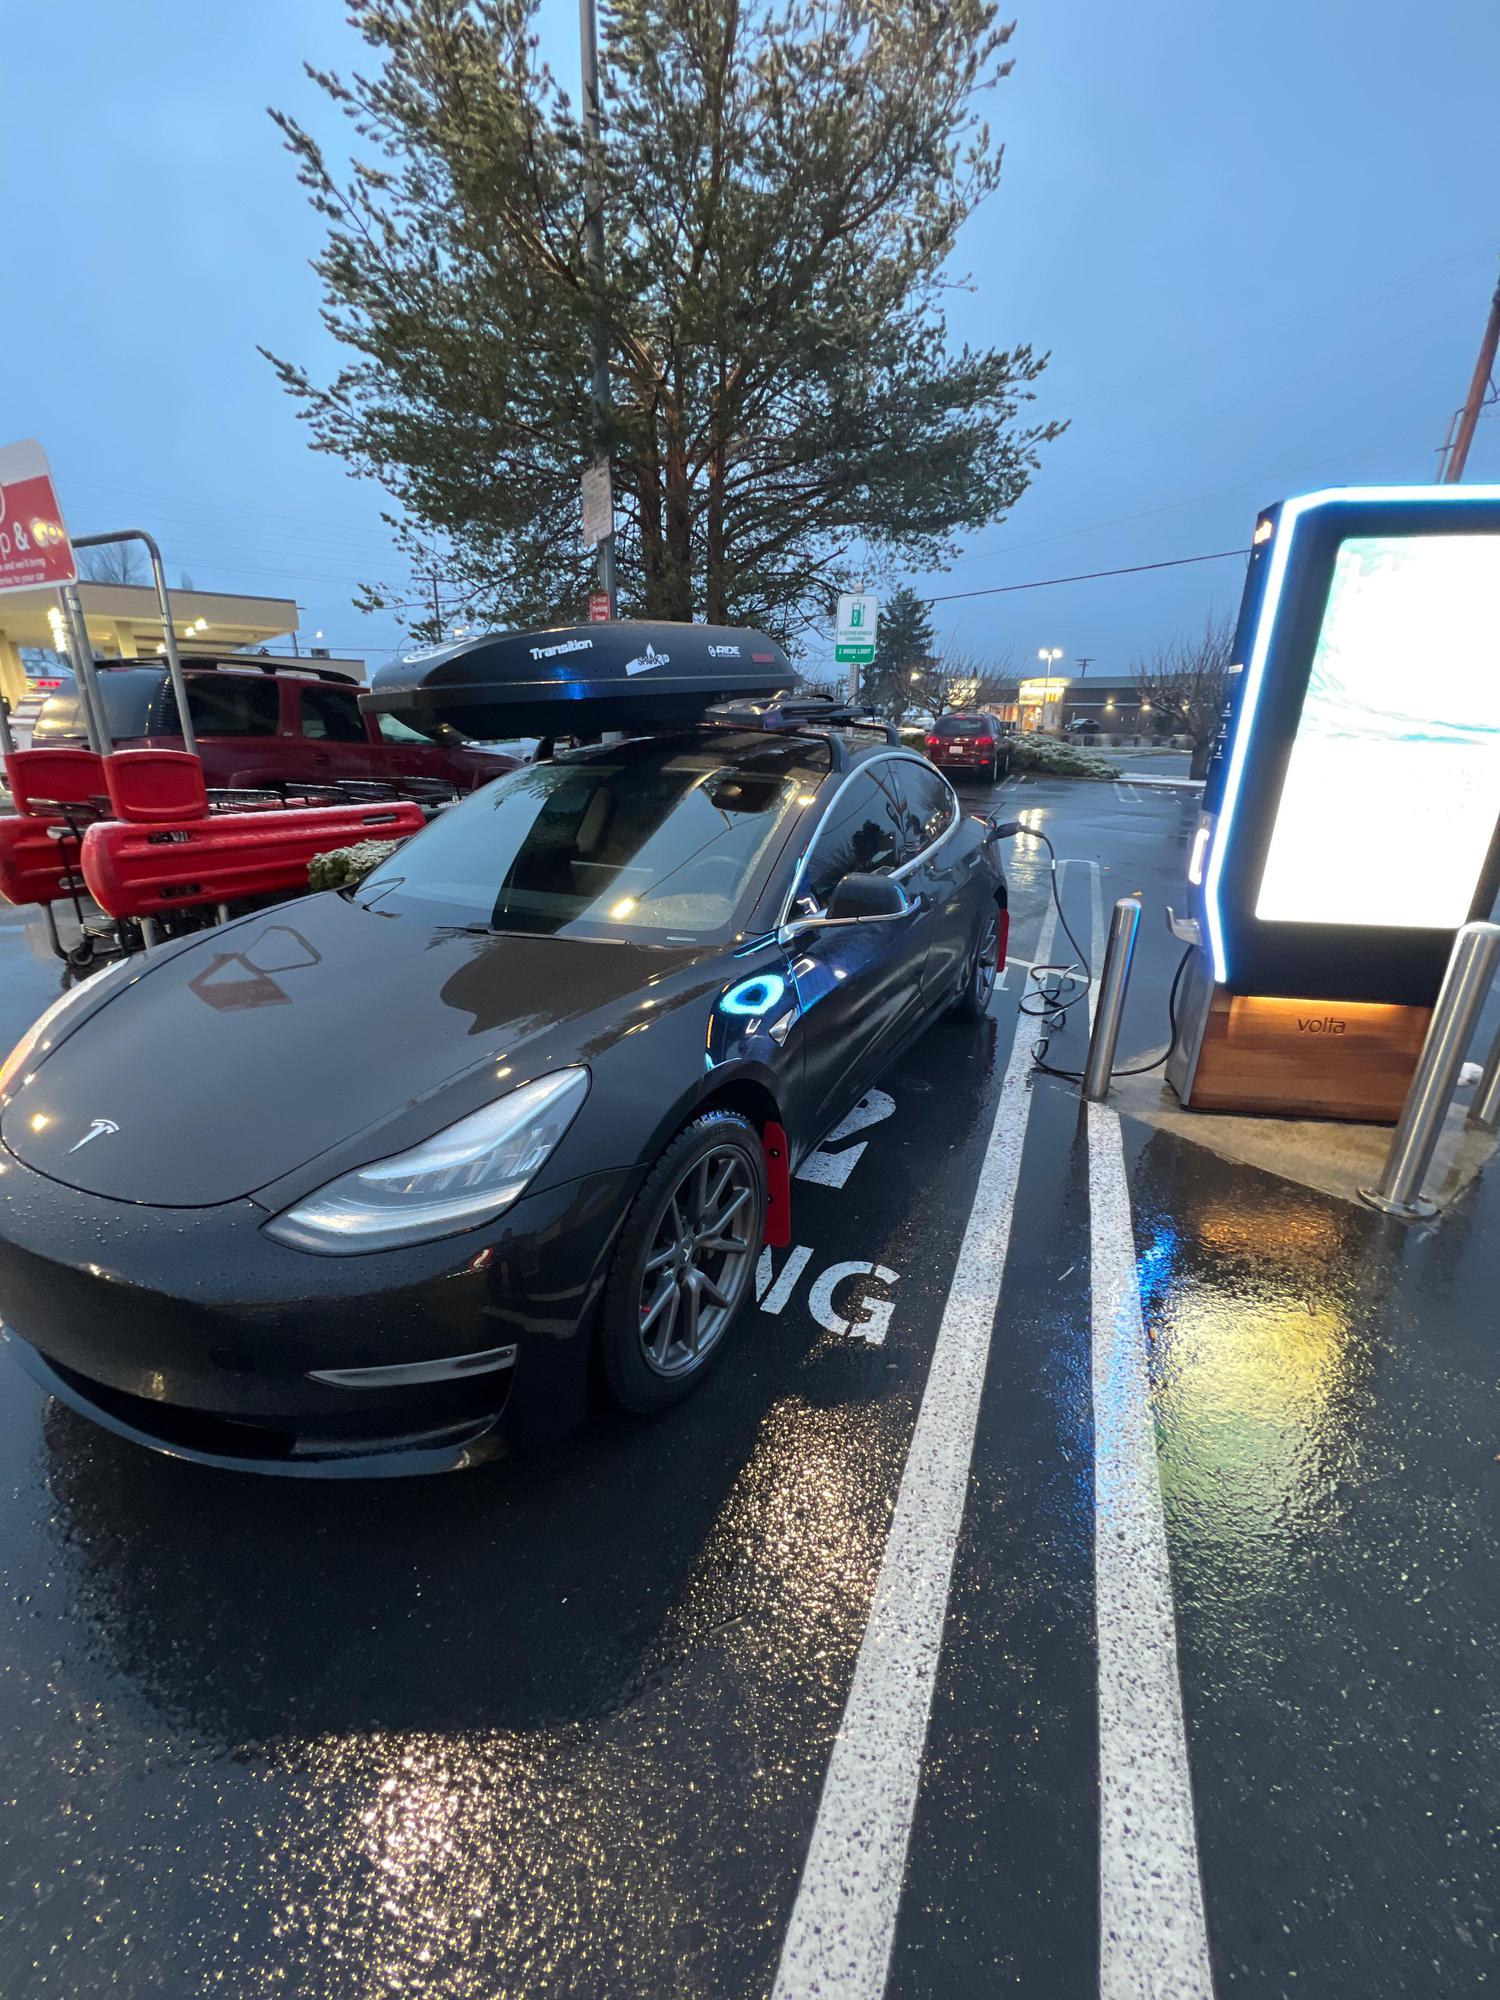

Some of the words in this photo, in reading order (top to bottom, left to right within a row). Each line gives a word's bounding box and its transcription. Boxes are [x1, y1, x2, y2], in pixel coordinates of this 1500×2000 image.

[13, 521, 30, 551] &
[530, 639, 593, 660] Transition
[716, 645, 740, 655] RIDE
[1297, 1017, 1345, 1034] volta
